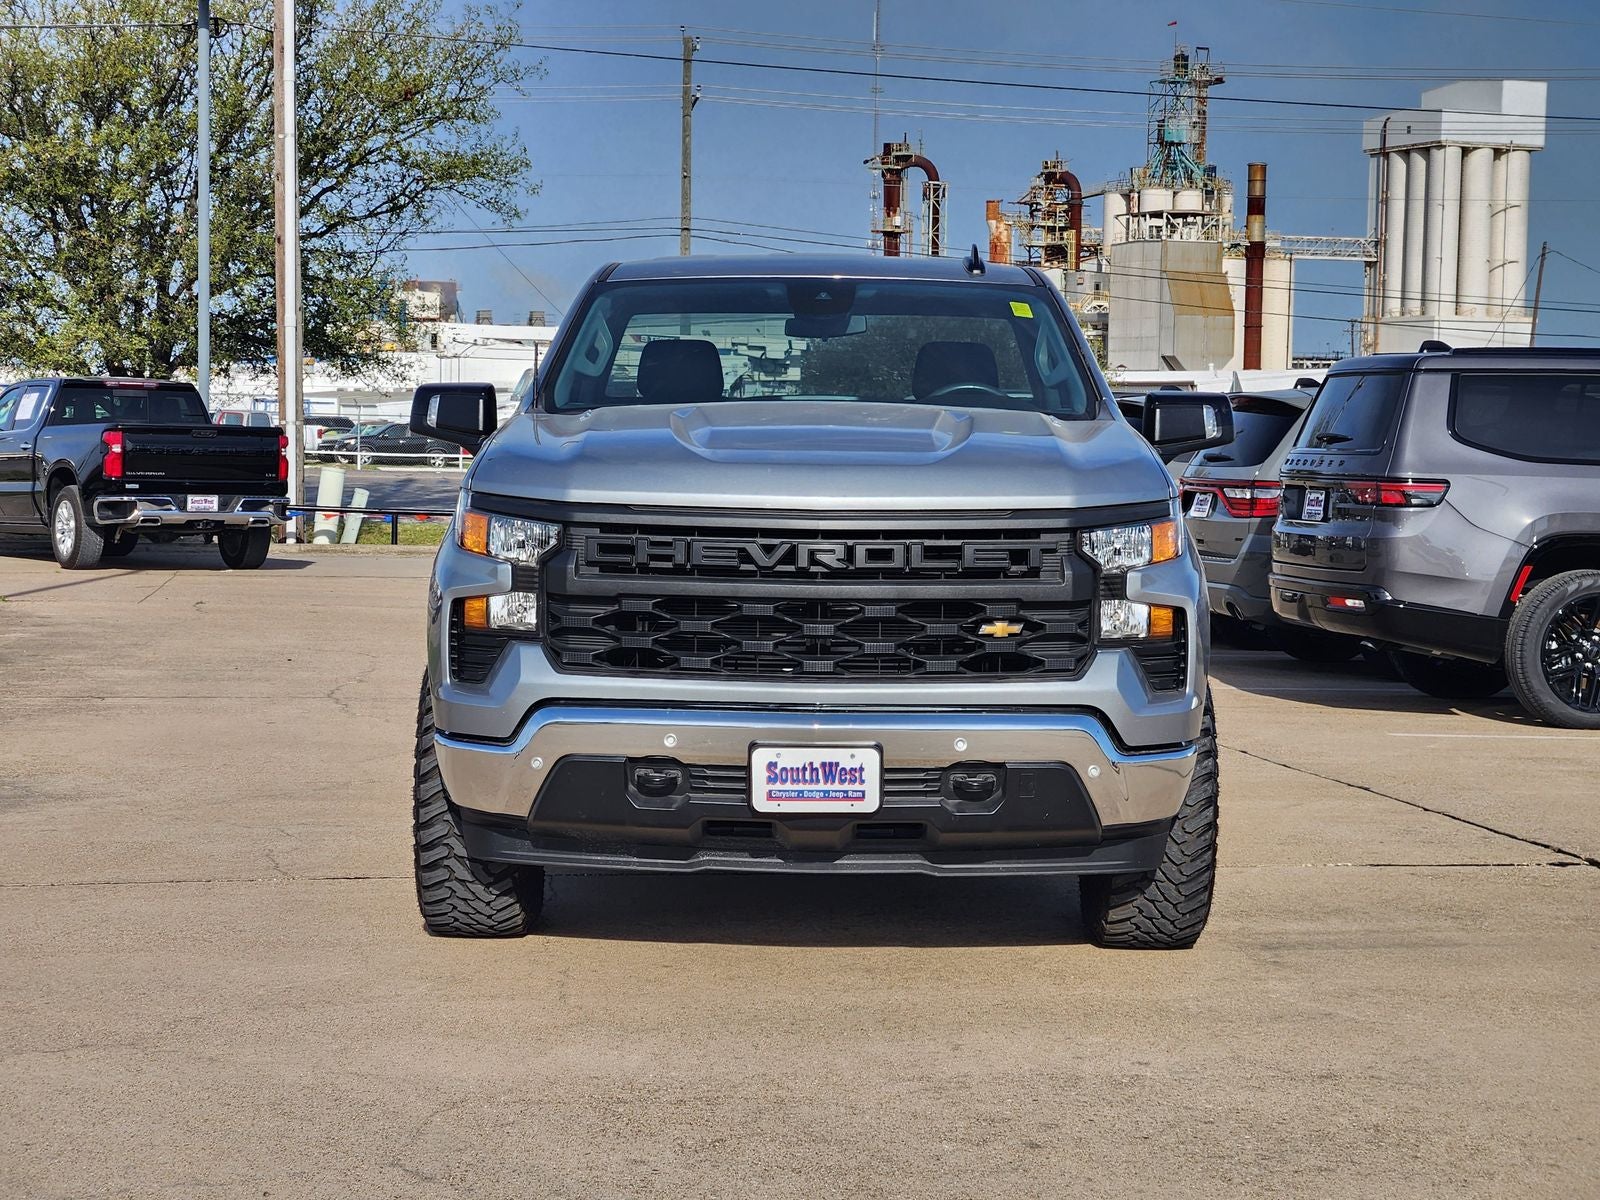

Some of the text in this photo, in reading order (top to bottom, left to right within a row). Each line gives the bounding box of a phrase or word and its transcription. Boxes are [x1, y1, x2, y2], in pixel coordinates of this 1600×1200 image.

[584, 534, 1060, 570] CHEVROLET
[766, 761, 866, 785] SouthWest
[771, 790, 863, 799] Chrysler Dodge Jeep Ram
